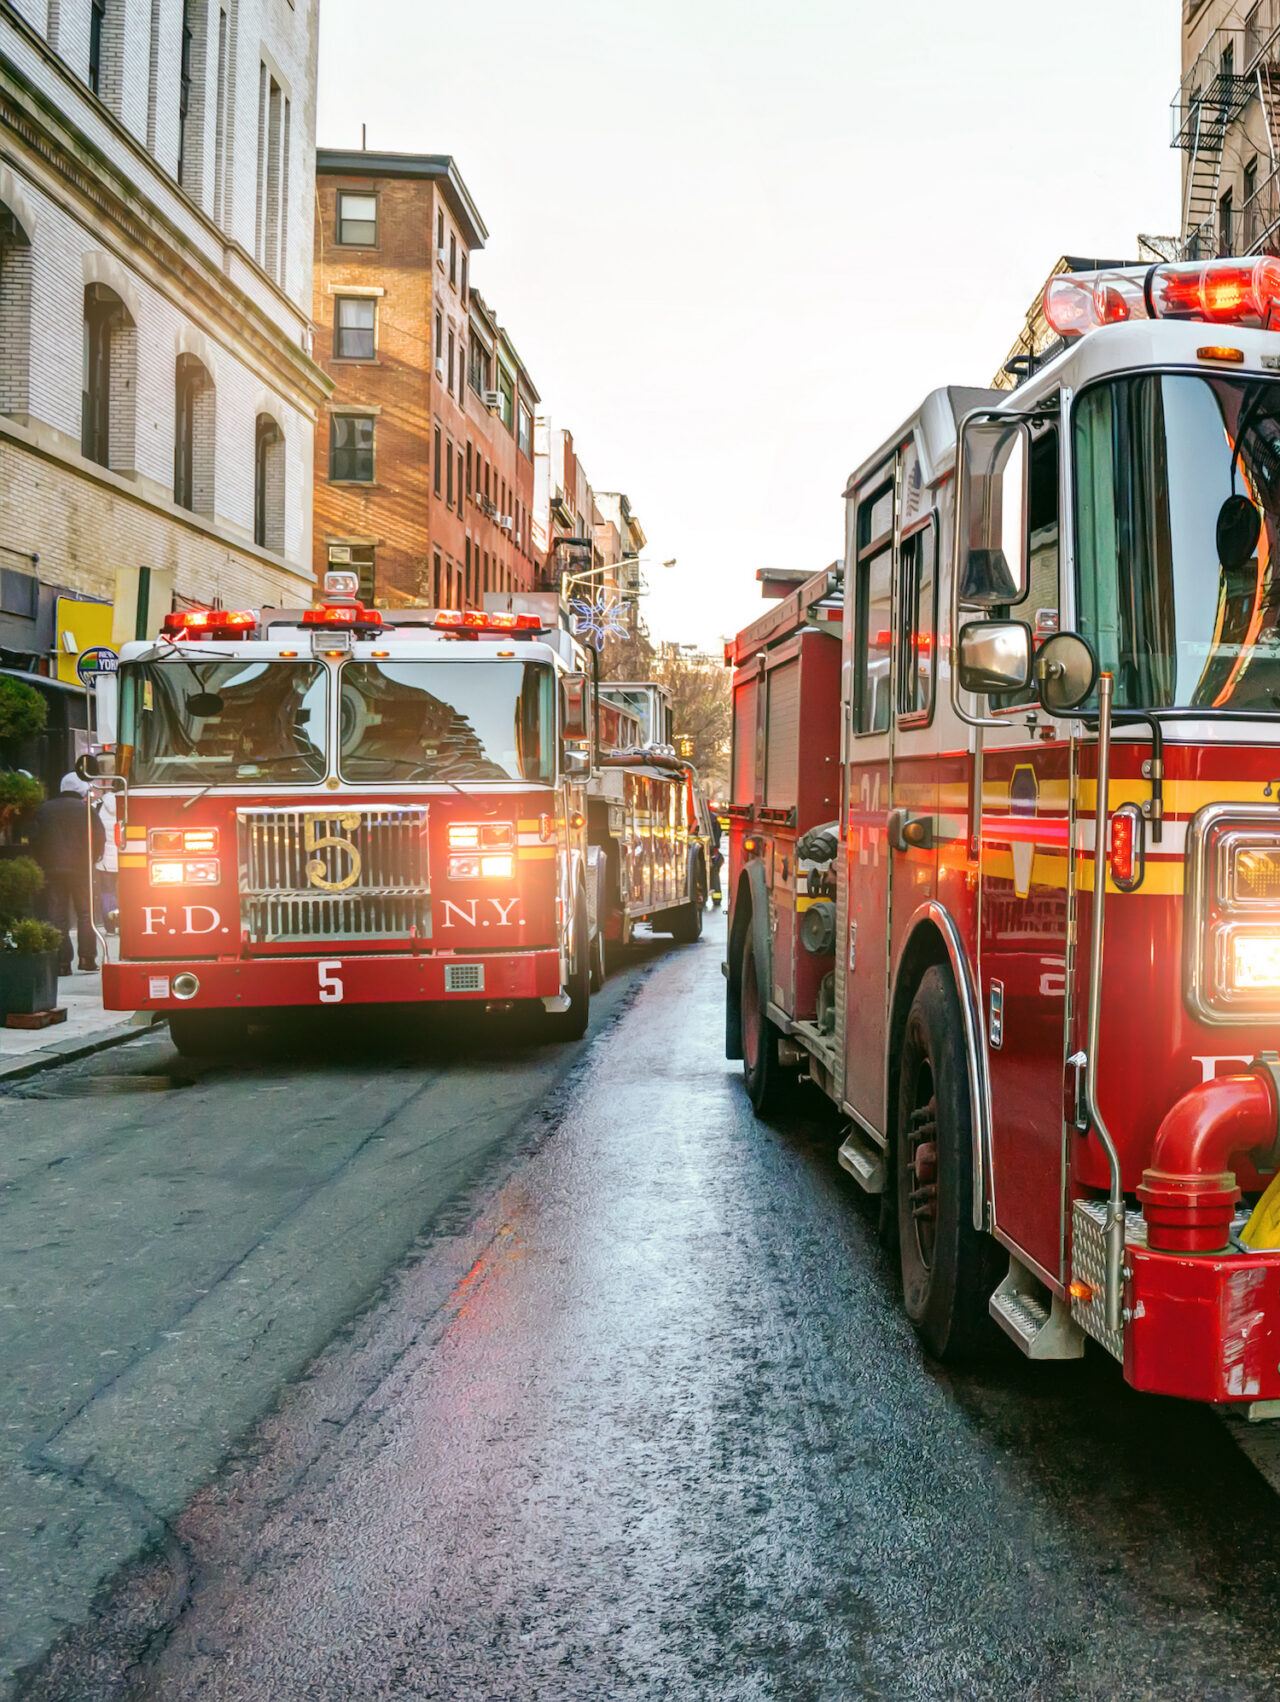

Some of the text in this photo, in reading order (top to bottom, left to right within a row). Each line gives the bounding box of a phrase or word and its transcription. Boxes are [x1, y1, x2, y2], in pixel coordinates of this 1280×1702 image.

[304, 812, 361, 892] 5
[141, 898, 526, 935] F.D. N.Y.
[318, 961, 343, 1002] 5
